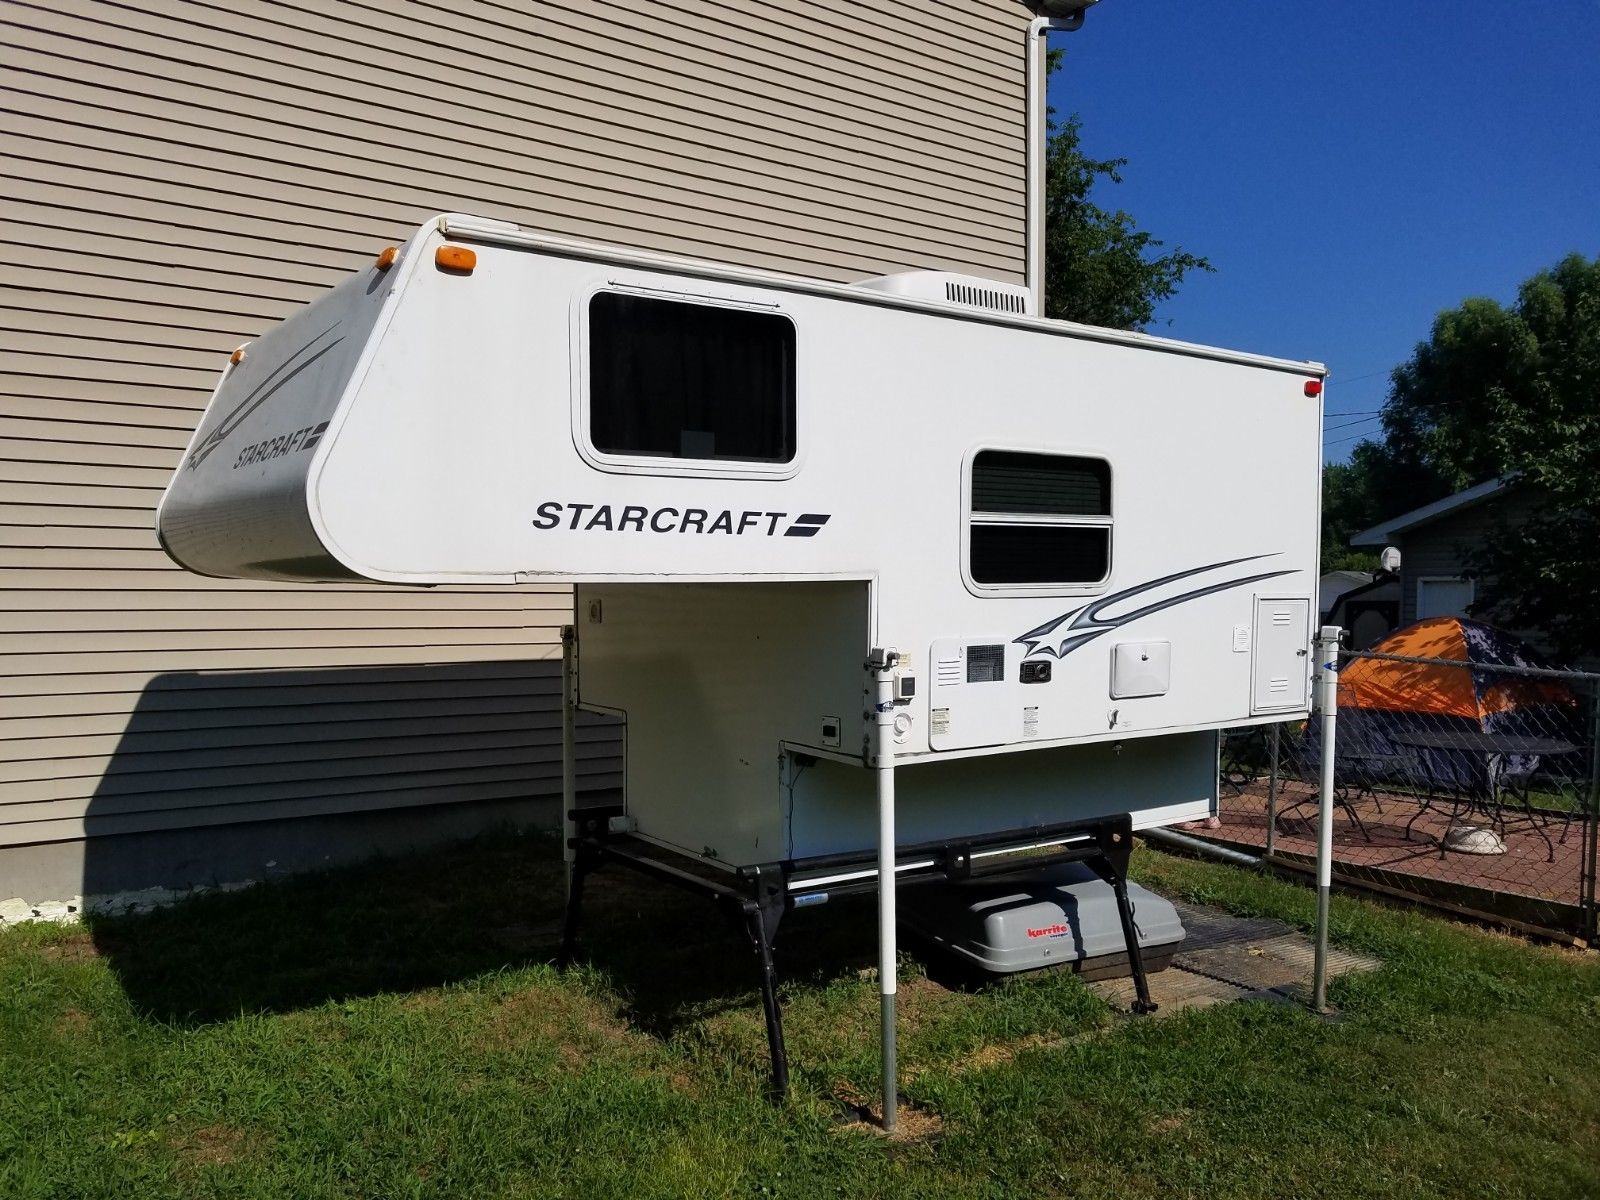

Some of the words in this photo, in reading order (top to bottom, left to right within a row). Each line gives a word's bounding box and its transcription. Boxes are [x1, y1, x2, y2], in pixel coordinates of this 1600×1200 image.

[232, 426, 314, 470] STARCRAFT
[532, 501, 787, 536] STARCRAFT
[1027, 924, 1067, 938] karrite
